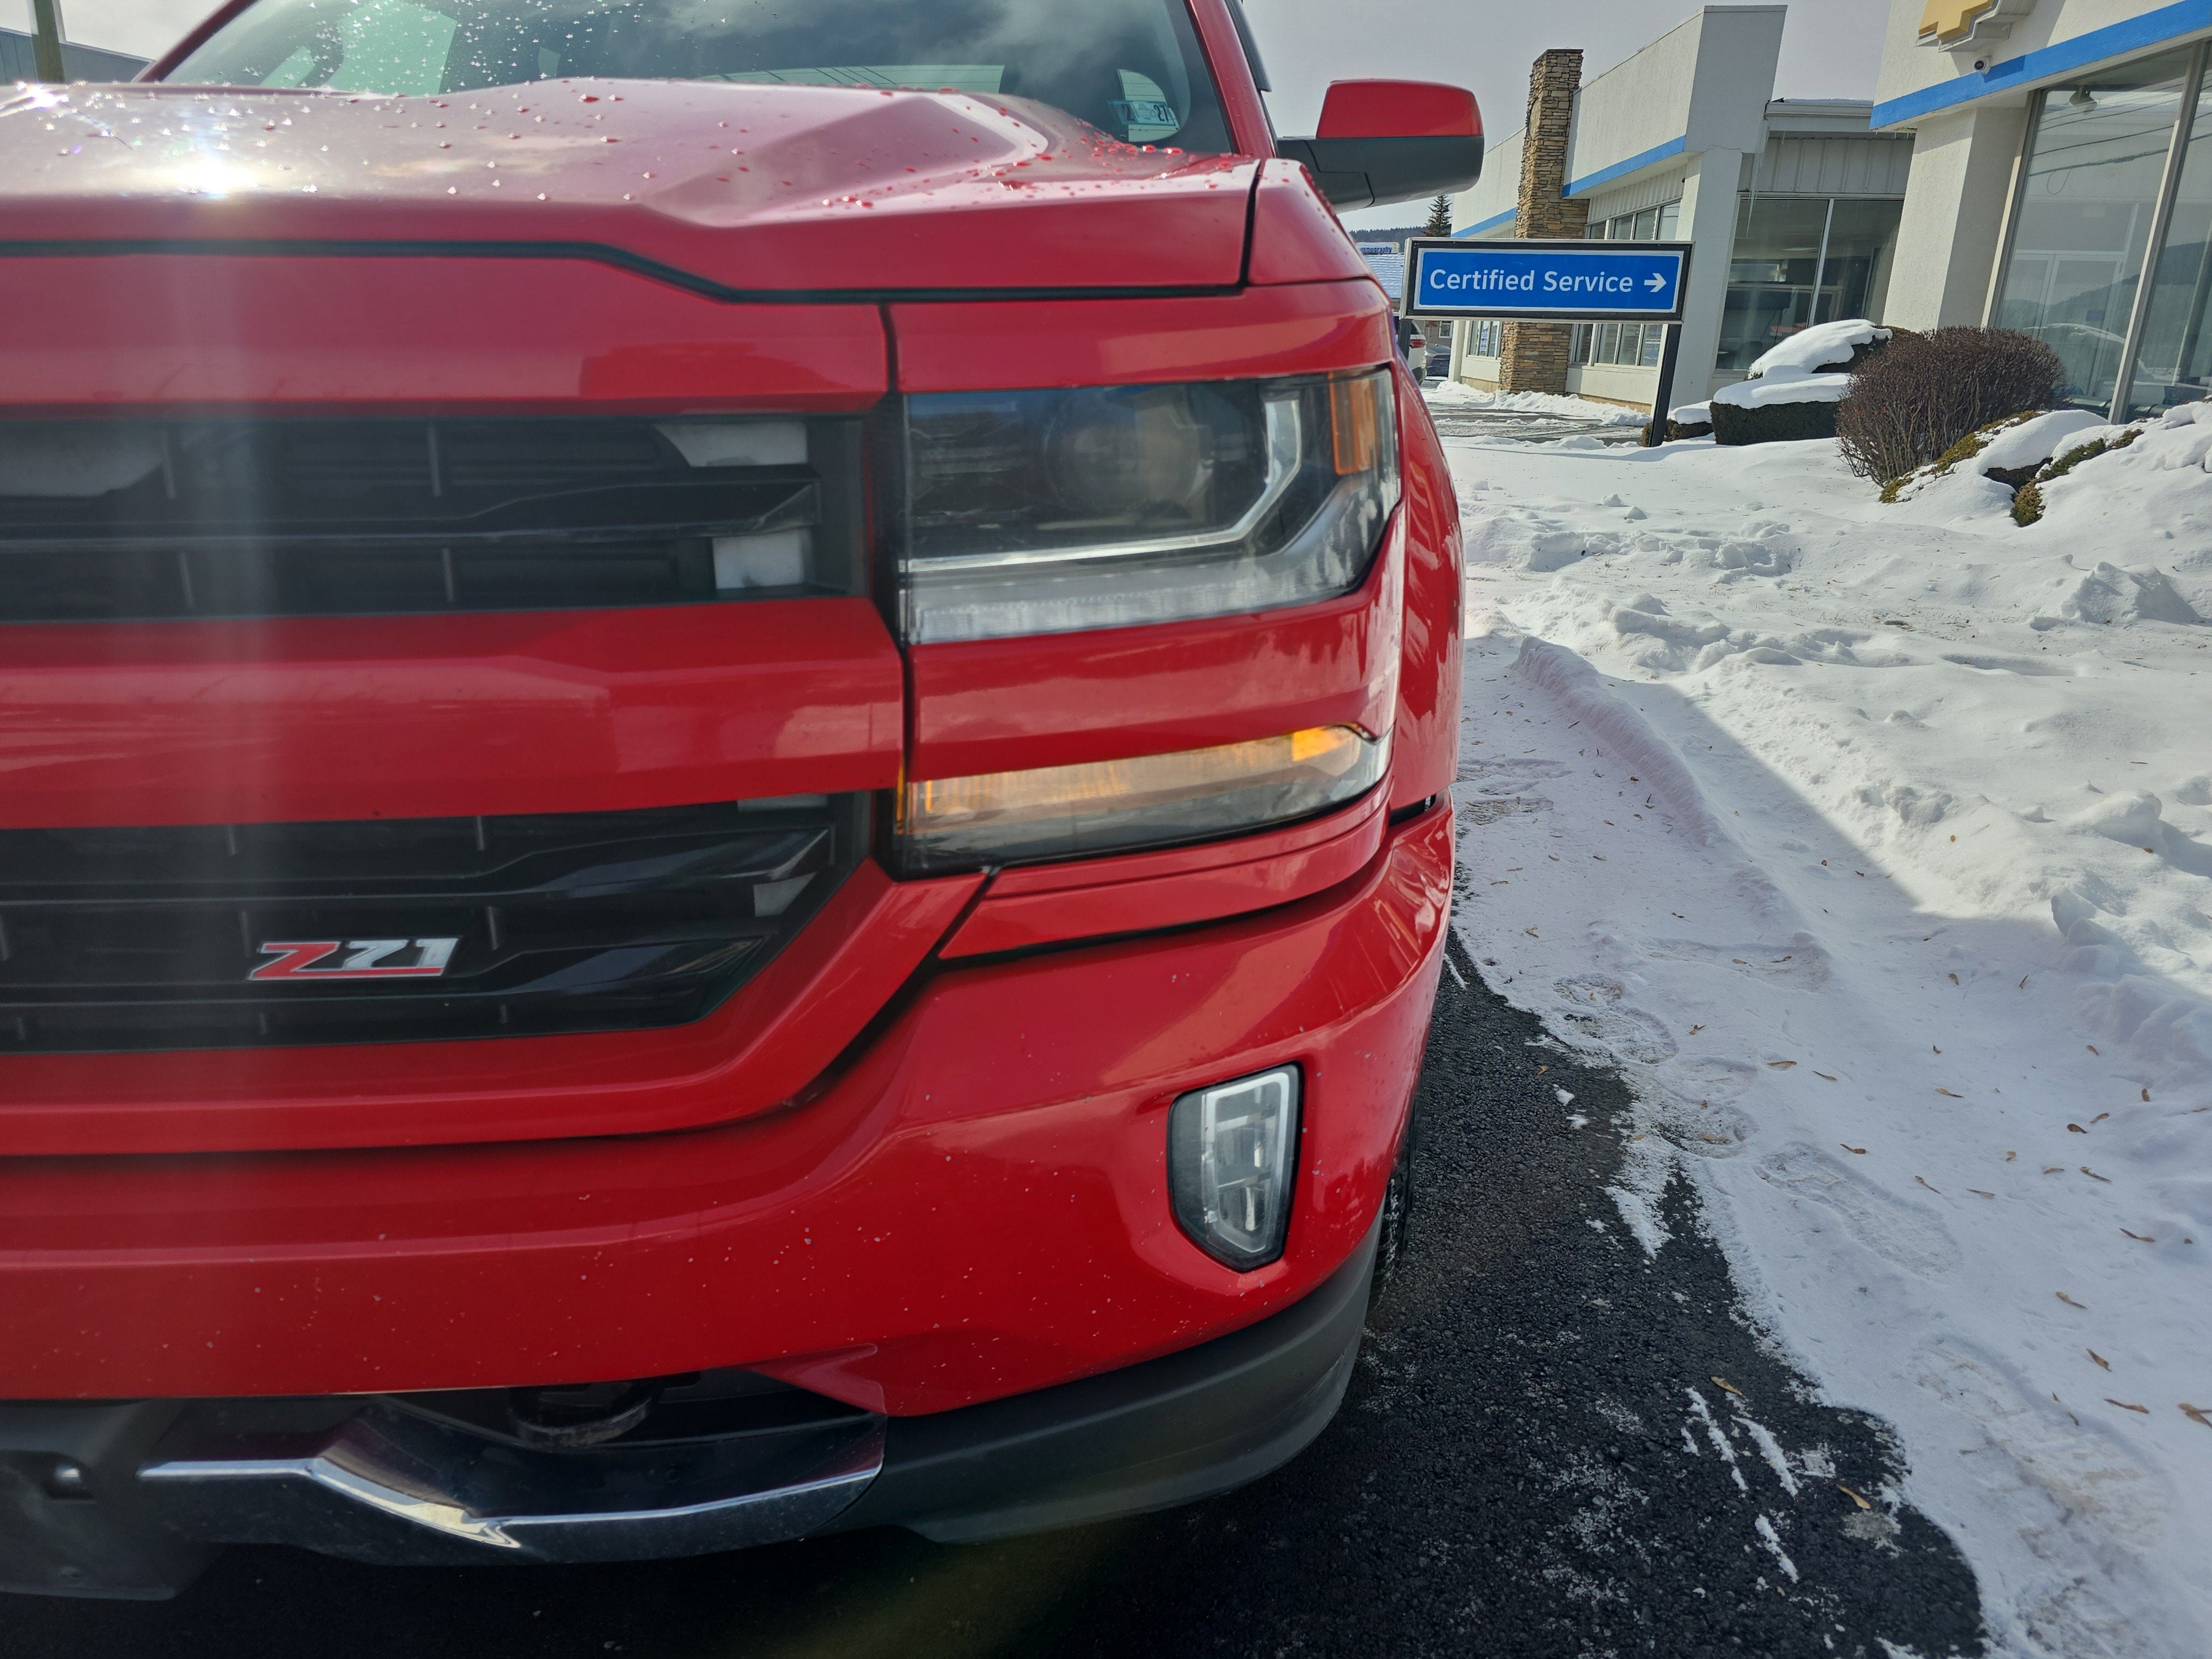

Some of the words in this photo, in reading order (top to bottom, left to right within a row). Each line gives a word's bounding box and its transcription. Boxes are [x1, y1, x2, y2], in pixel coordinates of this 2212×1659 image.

[1430, 269, 1534, 291] Certified
[1543, 271, 1634, 292] Service
[247, 937, 459, 980] Z71
